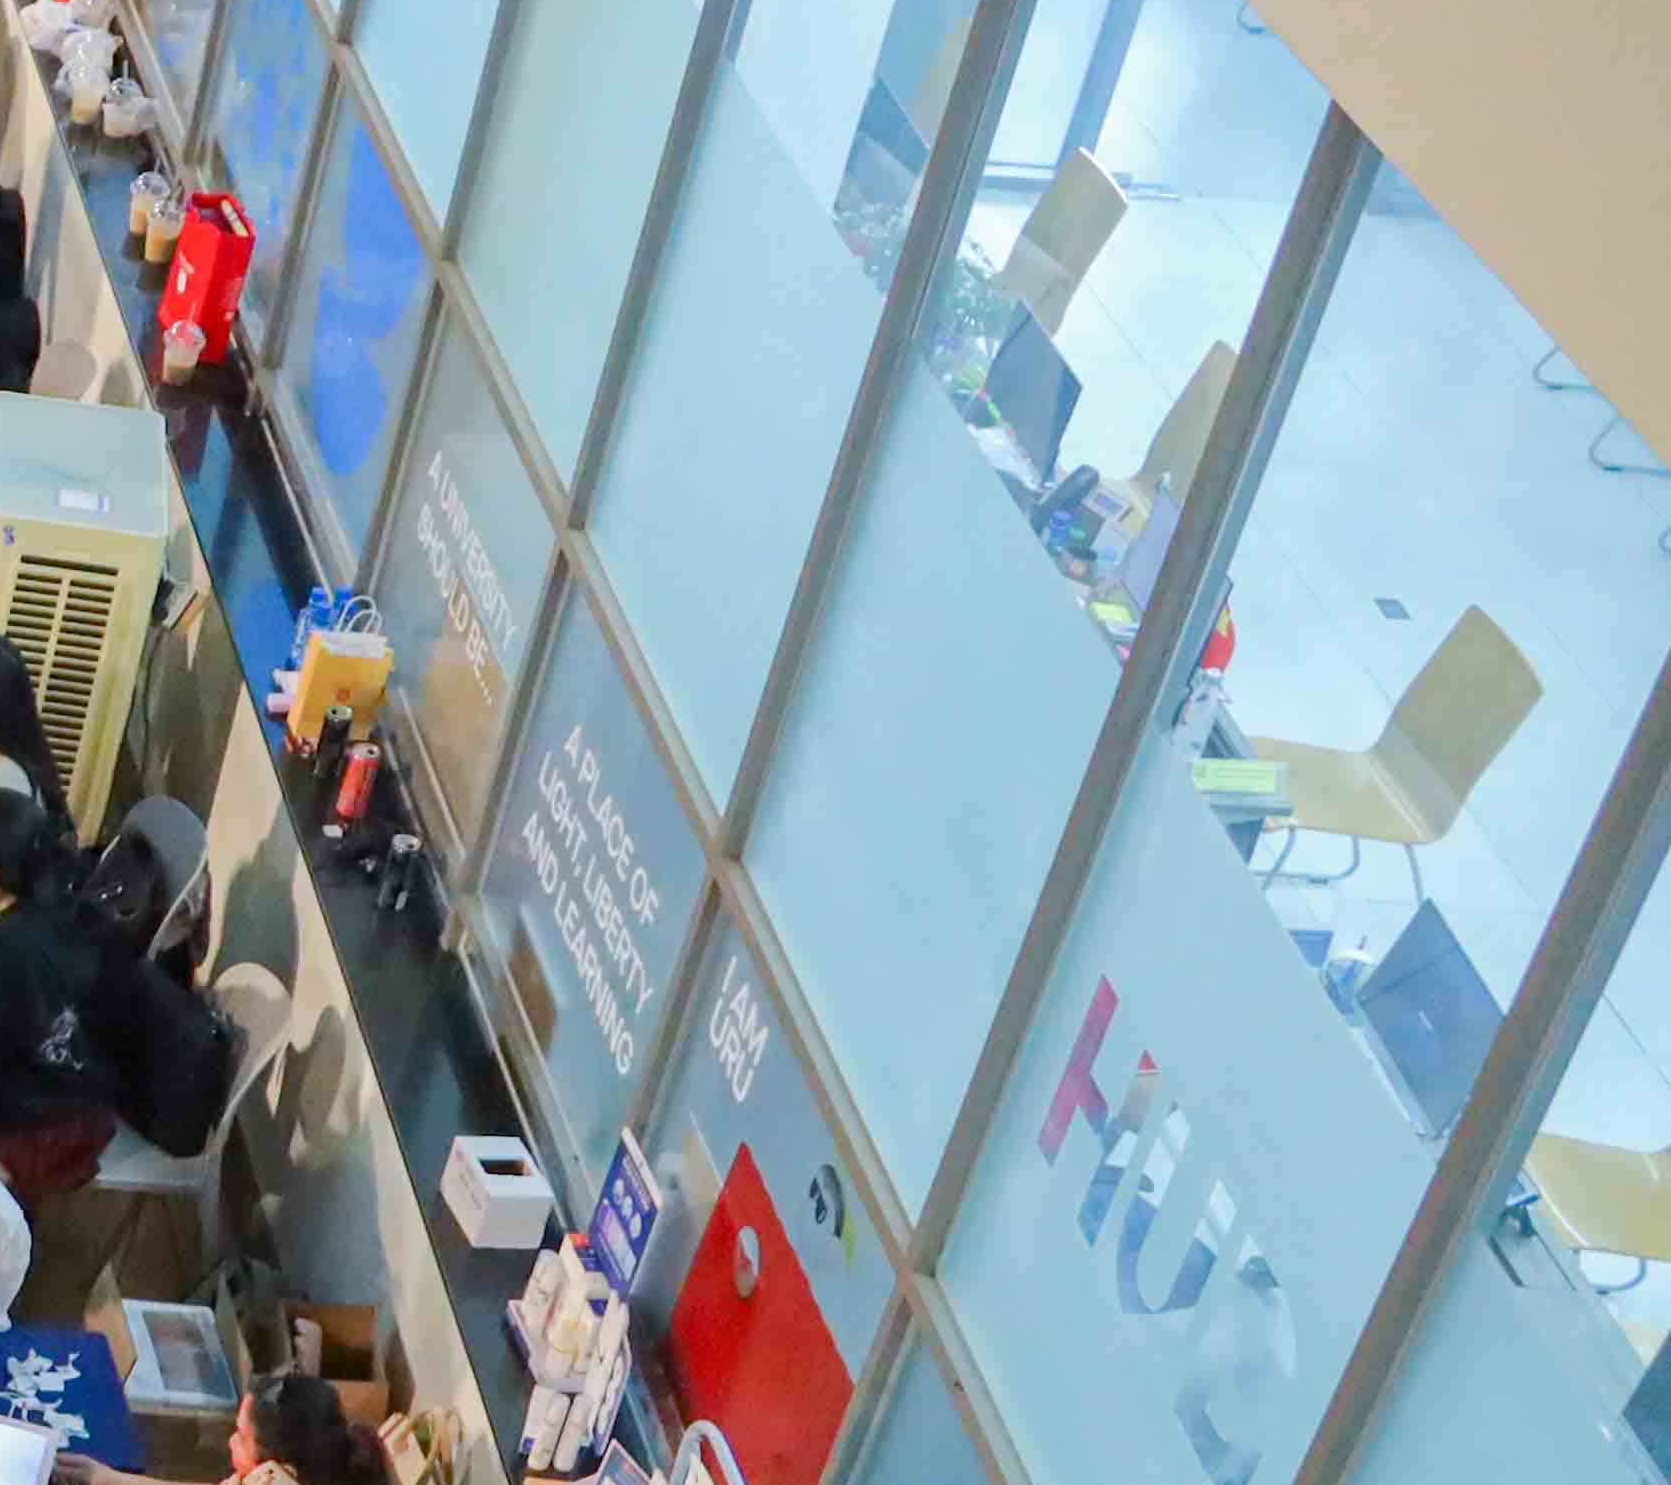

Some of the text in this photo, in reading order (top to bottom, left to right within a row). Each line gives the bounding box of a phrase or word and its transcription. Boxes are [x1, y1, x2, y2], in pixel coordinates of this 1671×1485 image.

[564, 723, 659, 925] A PLACE OF
[521, 812, 634, 1075] AND LEARNING
[583, 855, 654, 1014] LIBERTY
[721, 955, 769, 1067] I AM
